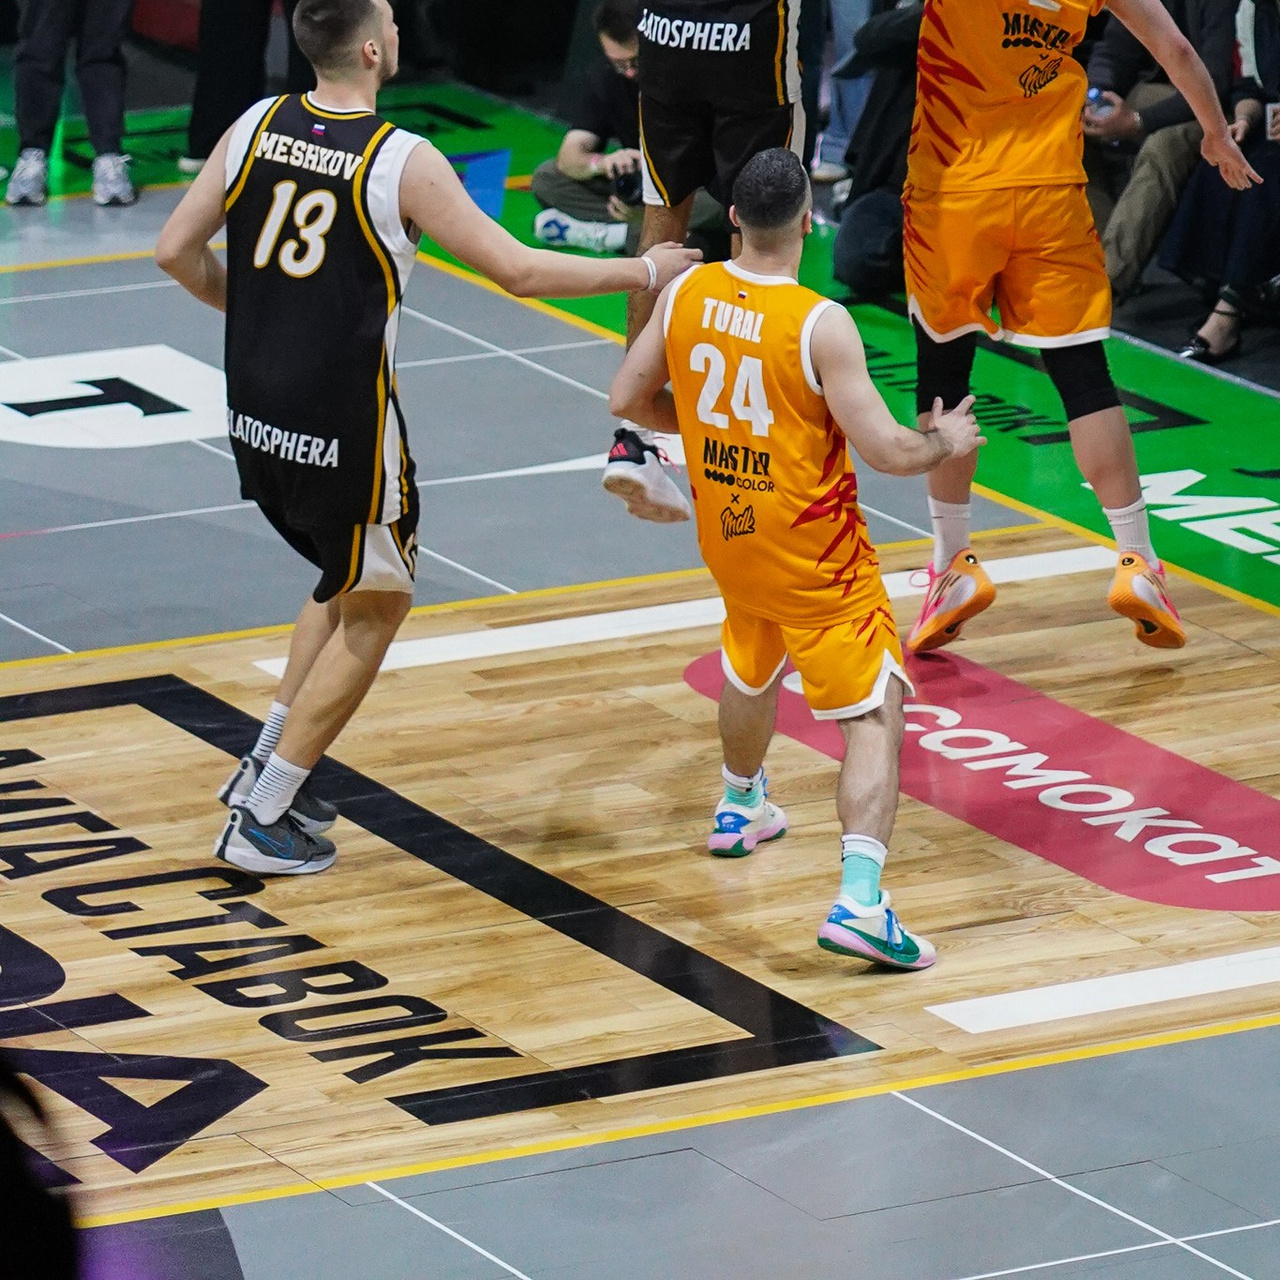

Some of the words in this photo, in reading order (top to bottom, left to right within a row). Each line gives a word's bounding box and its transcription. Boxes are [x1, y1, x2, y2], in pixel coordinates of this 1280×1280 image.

[254, 130, 365, 181] MESHKOV
[253, 179, 338, 279] 13
[701, 297, 765, 344] TURAL
[689, 342, 775, 438] 24
[227, 408, 340, 468] LATOSPHERA
[703, 436, 771, 477] MASTER
[736, 475, 775, 493] COLOR
